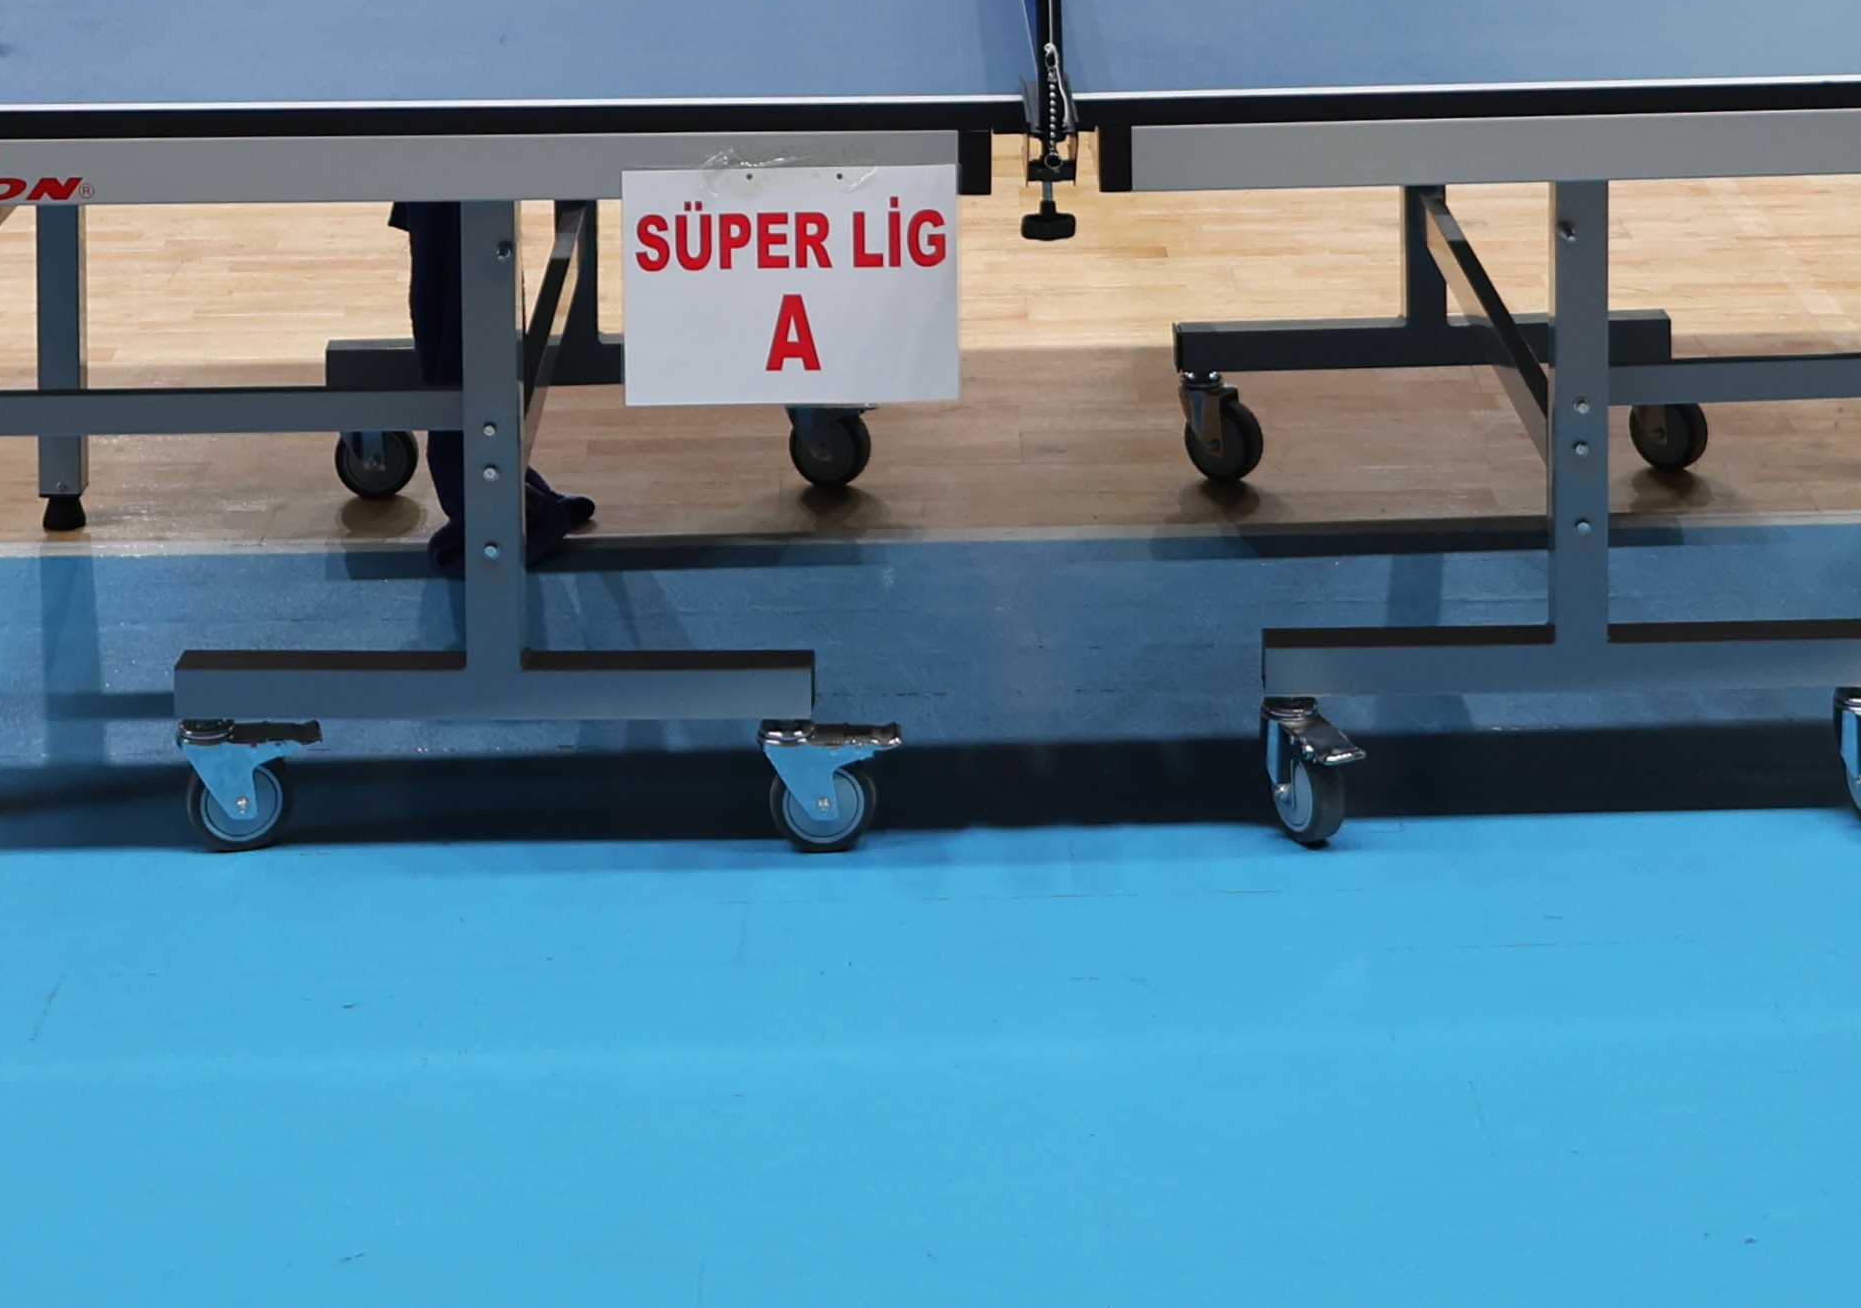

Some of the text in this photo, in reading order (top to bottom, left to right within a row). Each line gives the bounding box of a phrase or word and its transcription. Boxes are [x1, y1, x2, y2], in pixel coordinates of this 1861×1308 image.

[635, 195, 947, 270] SÜPER LİG
[765, 294, 822, 373] A
